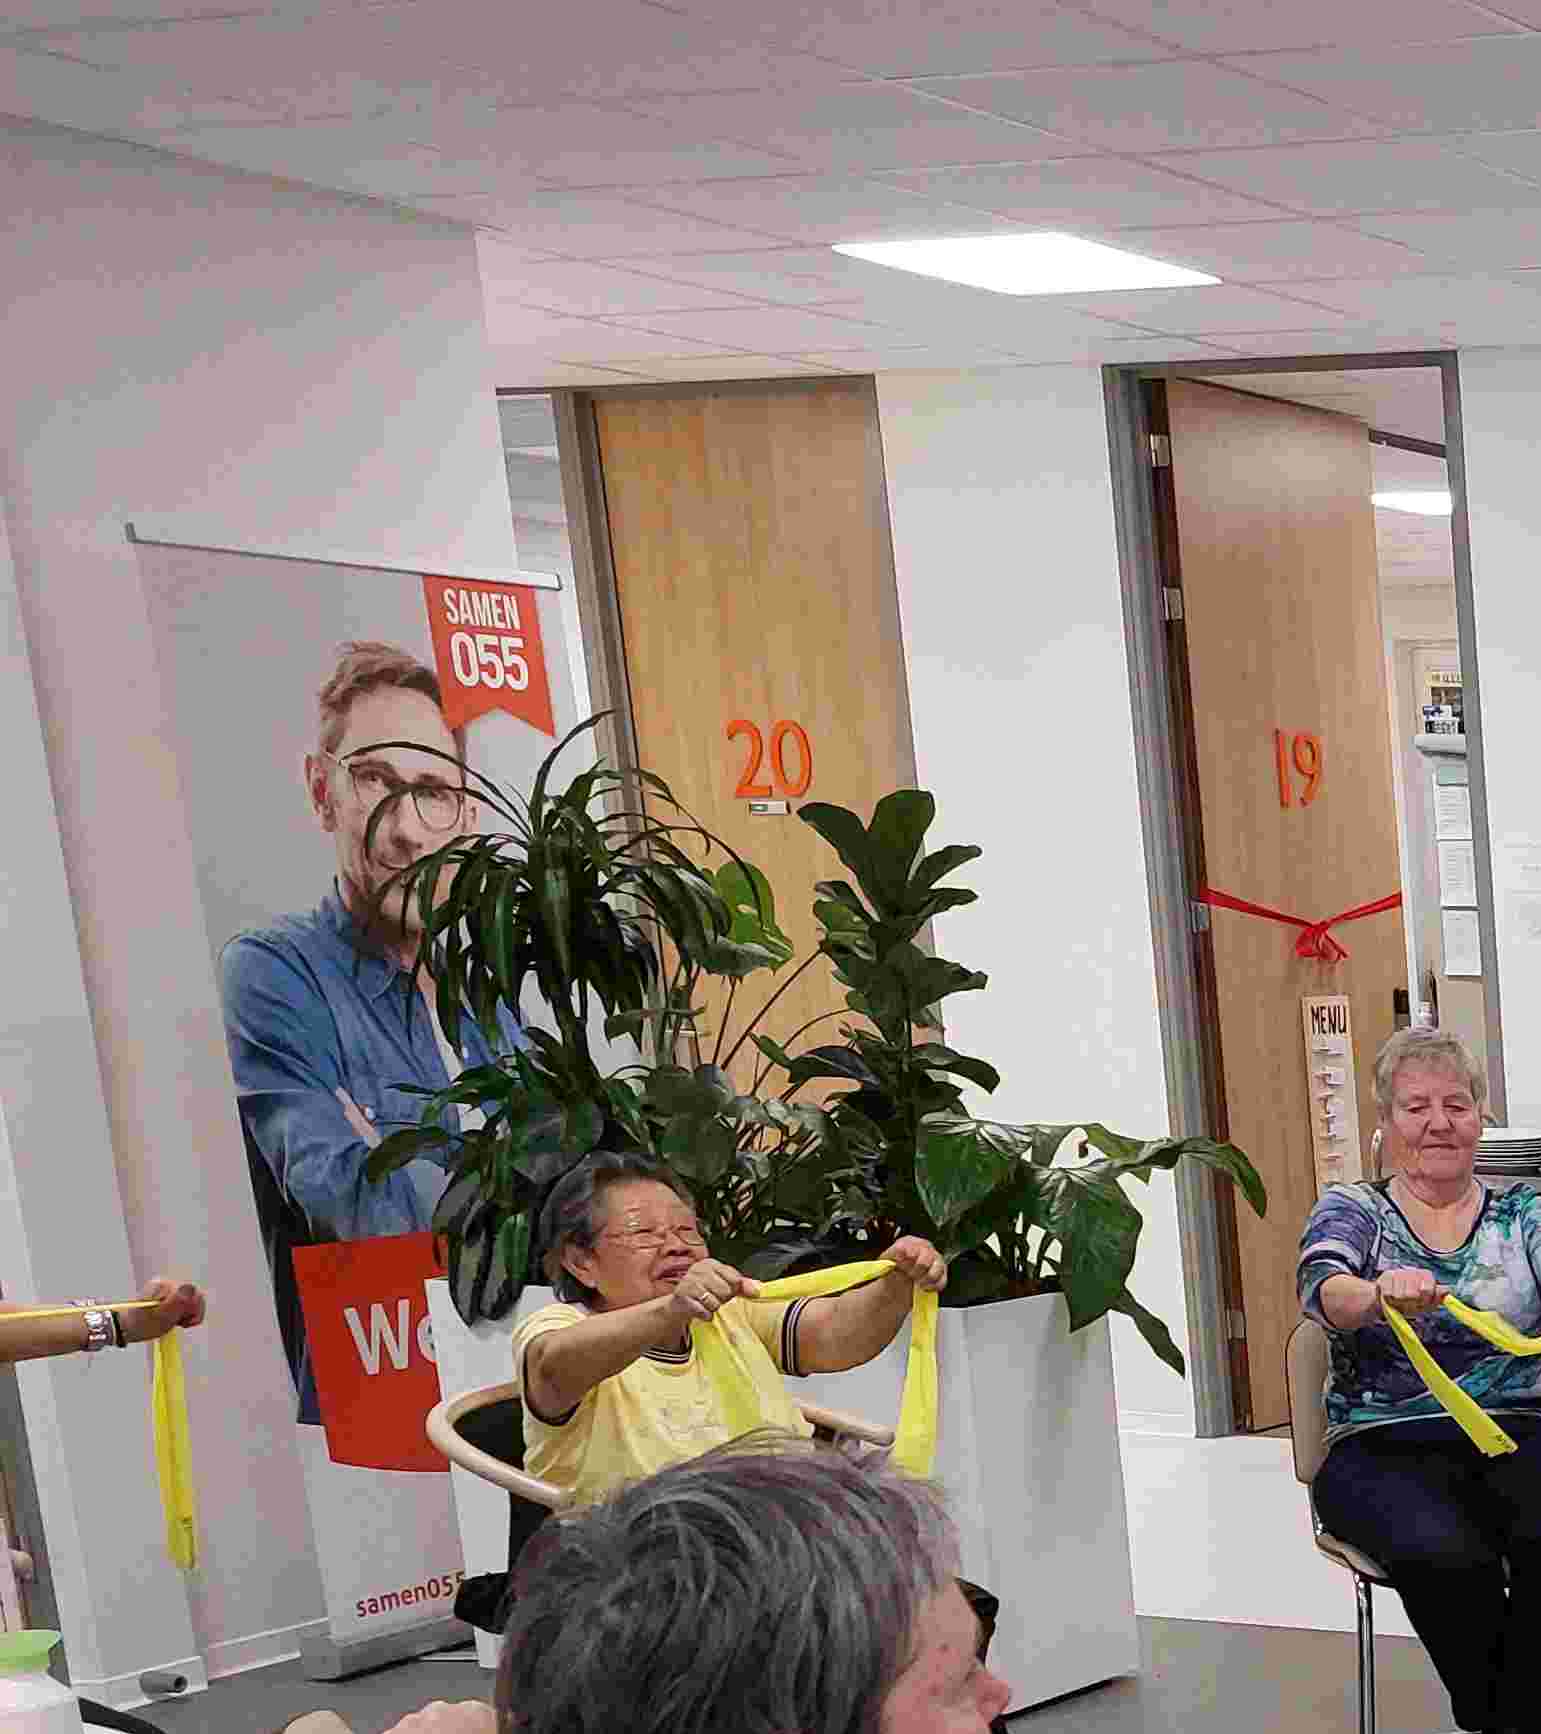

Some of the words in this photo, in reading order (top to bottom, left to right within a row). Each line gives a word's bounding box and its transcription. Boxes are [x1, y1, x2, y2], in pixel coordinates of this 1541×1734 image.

[442, 587, 520, 630] SAMEN
[450, 633, 529, 691] 055
[727, 718, 814, 799] 20
[1272, 728, 1325, 809] 19
[1310, 1004, 1347, 1035] MENU
